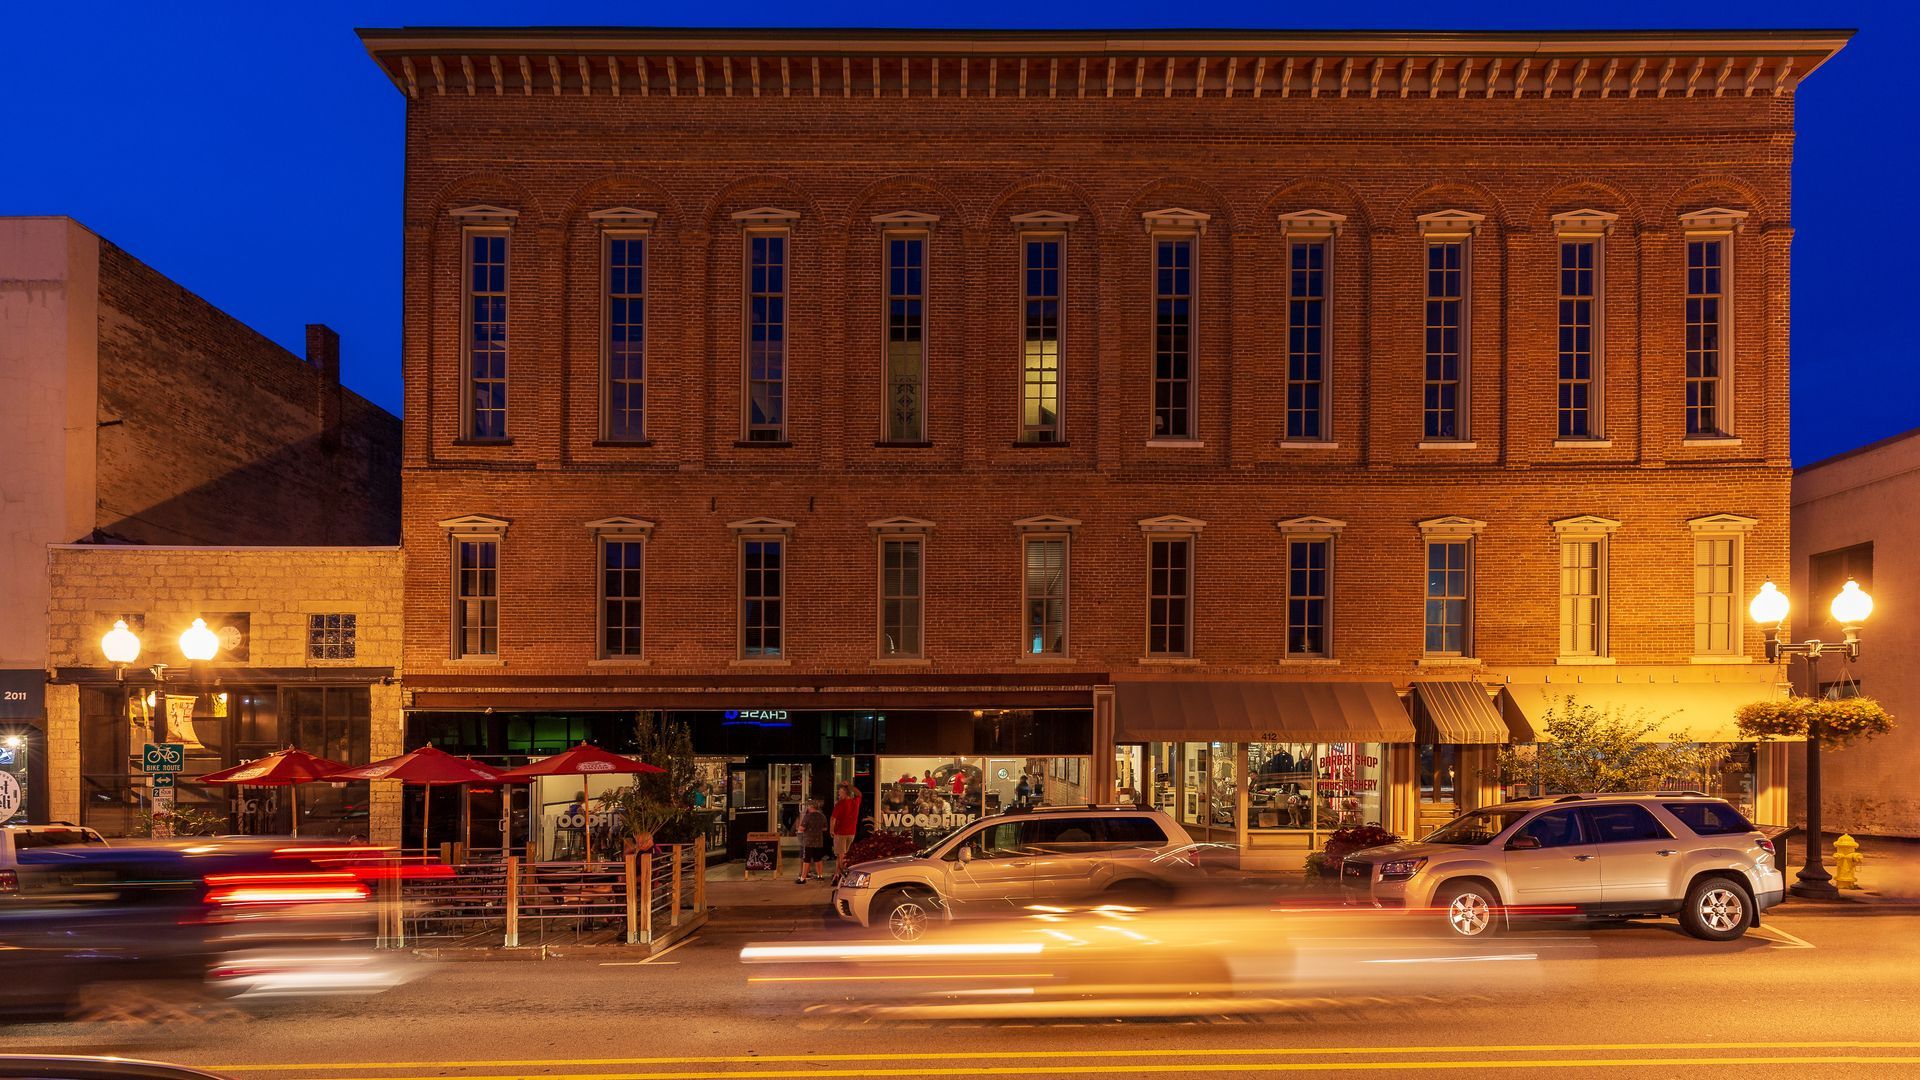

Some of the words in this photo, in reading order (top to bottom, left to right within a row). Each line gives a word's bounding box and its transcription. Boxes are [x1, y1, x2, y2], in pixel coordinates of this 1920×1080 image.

[4, 691, 27, 700] 2011
[1261, 733, 1277, 741] 412
[1319, 754, 1353, 769] BARBER
[1355, 755, 1378, 768] SHOP
[154, 789, 159, 797] 2
